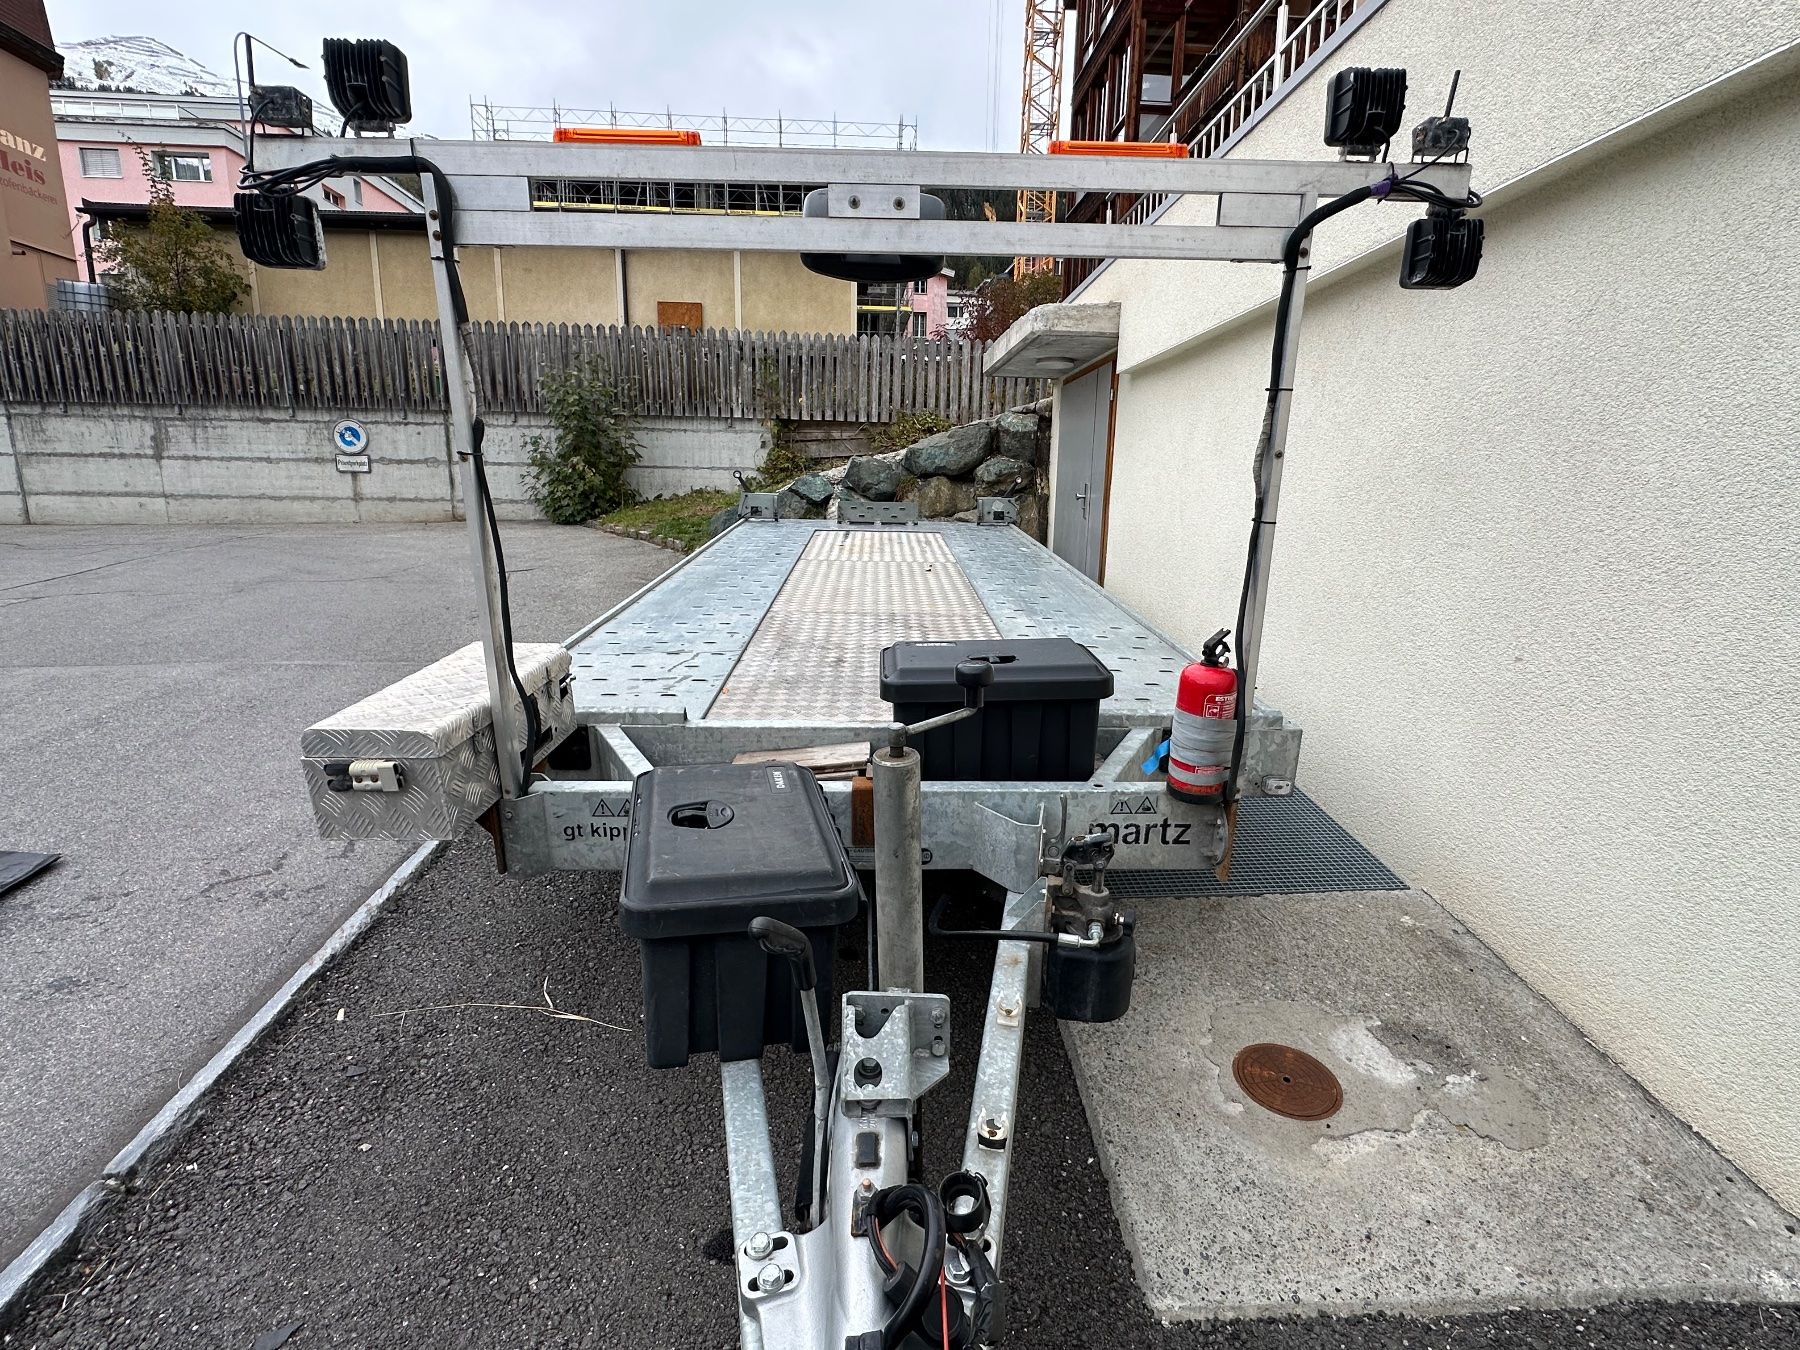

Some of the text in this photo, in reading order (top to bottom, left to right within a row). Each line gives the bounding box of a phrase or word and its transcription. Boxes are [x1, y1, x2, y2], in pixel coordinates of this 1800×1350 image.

[0, 129, 47, 162] anz
[563, 823, 584, 842] gt
[1088, 816, 1192, 846] martz
